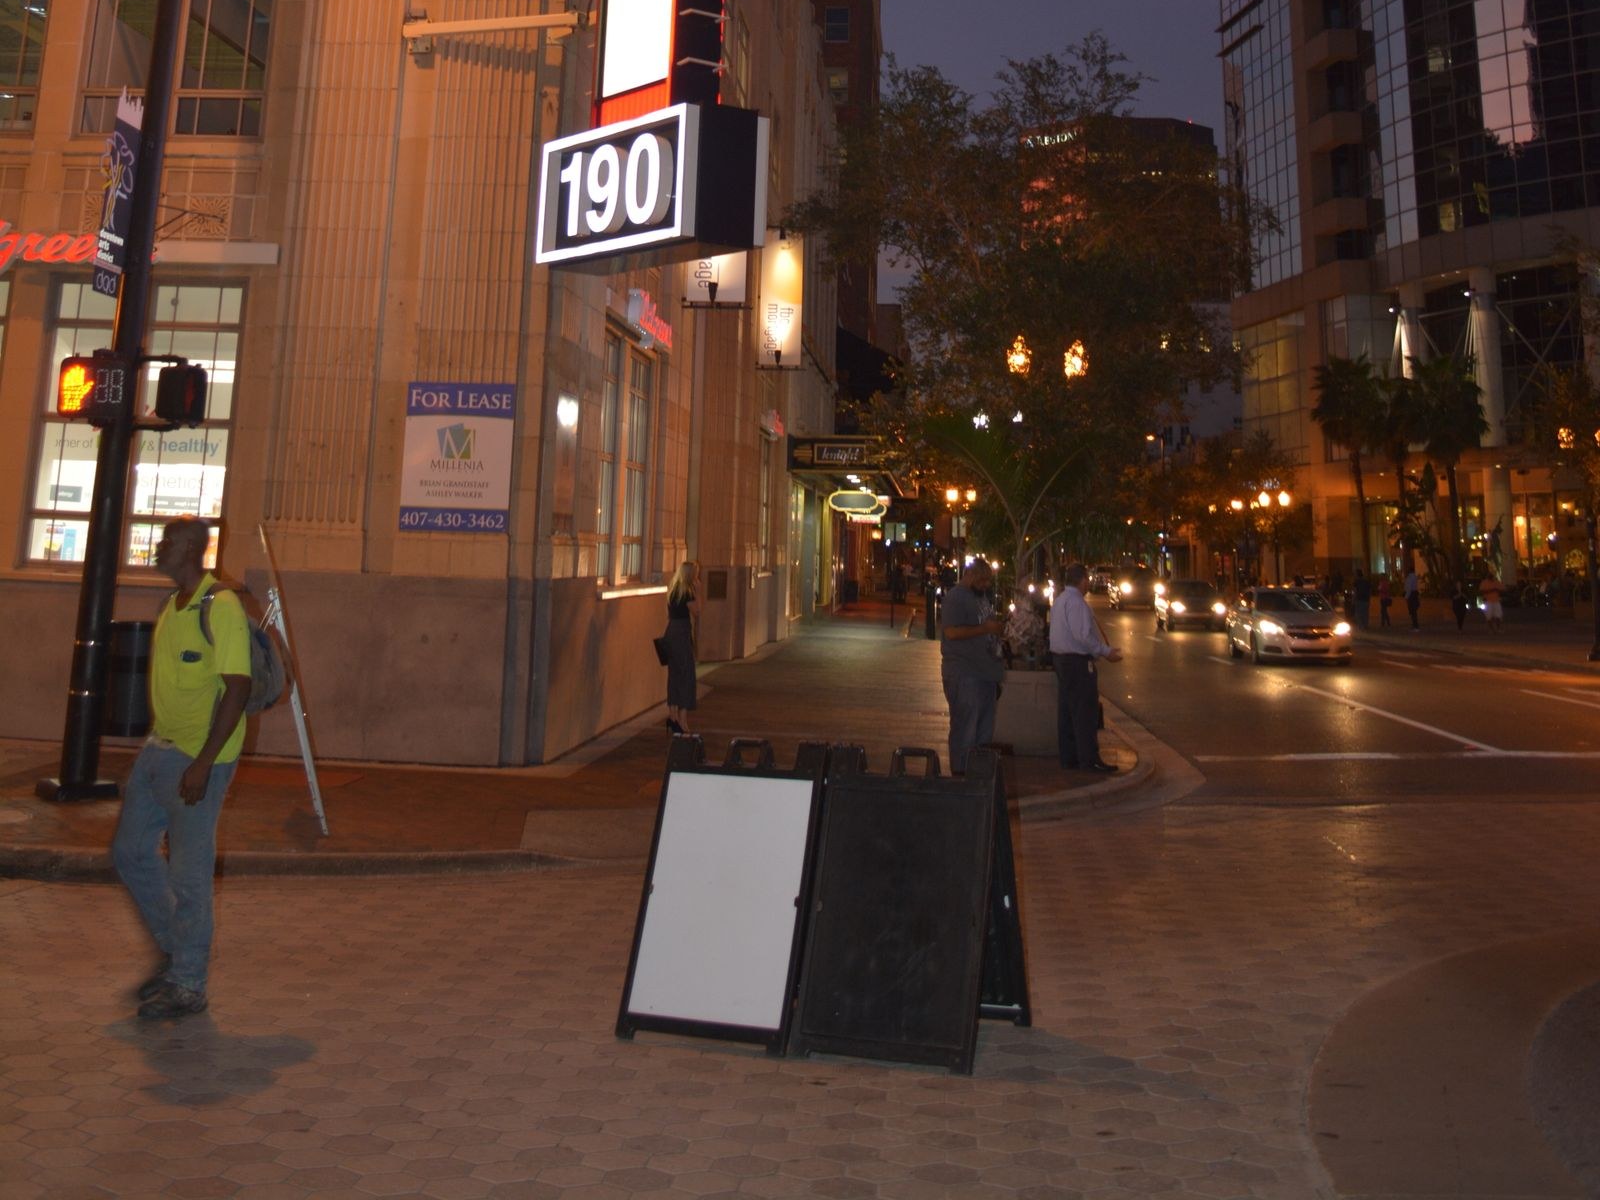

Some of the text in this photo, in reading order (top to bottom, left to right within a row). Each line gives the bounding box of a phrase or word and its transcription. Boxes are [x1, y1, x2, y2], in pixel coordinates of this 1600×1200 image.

[560, 132, 661, 237] 190
[411, 388, 512, 410] FOR LEASE
[158, 437, 219, 457] healthy
[430, 459, 484, 471] MILLENIA
[141, 474, 203, 490] smetics
[401, 511, 505, 529] 407-430-3462
